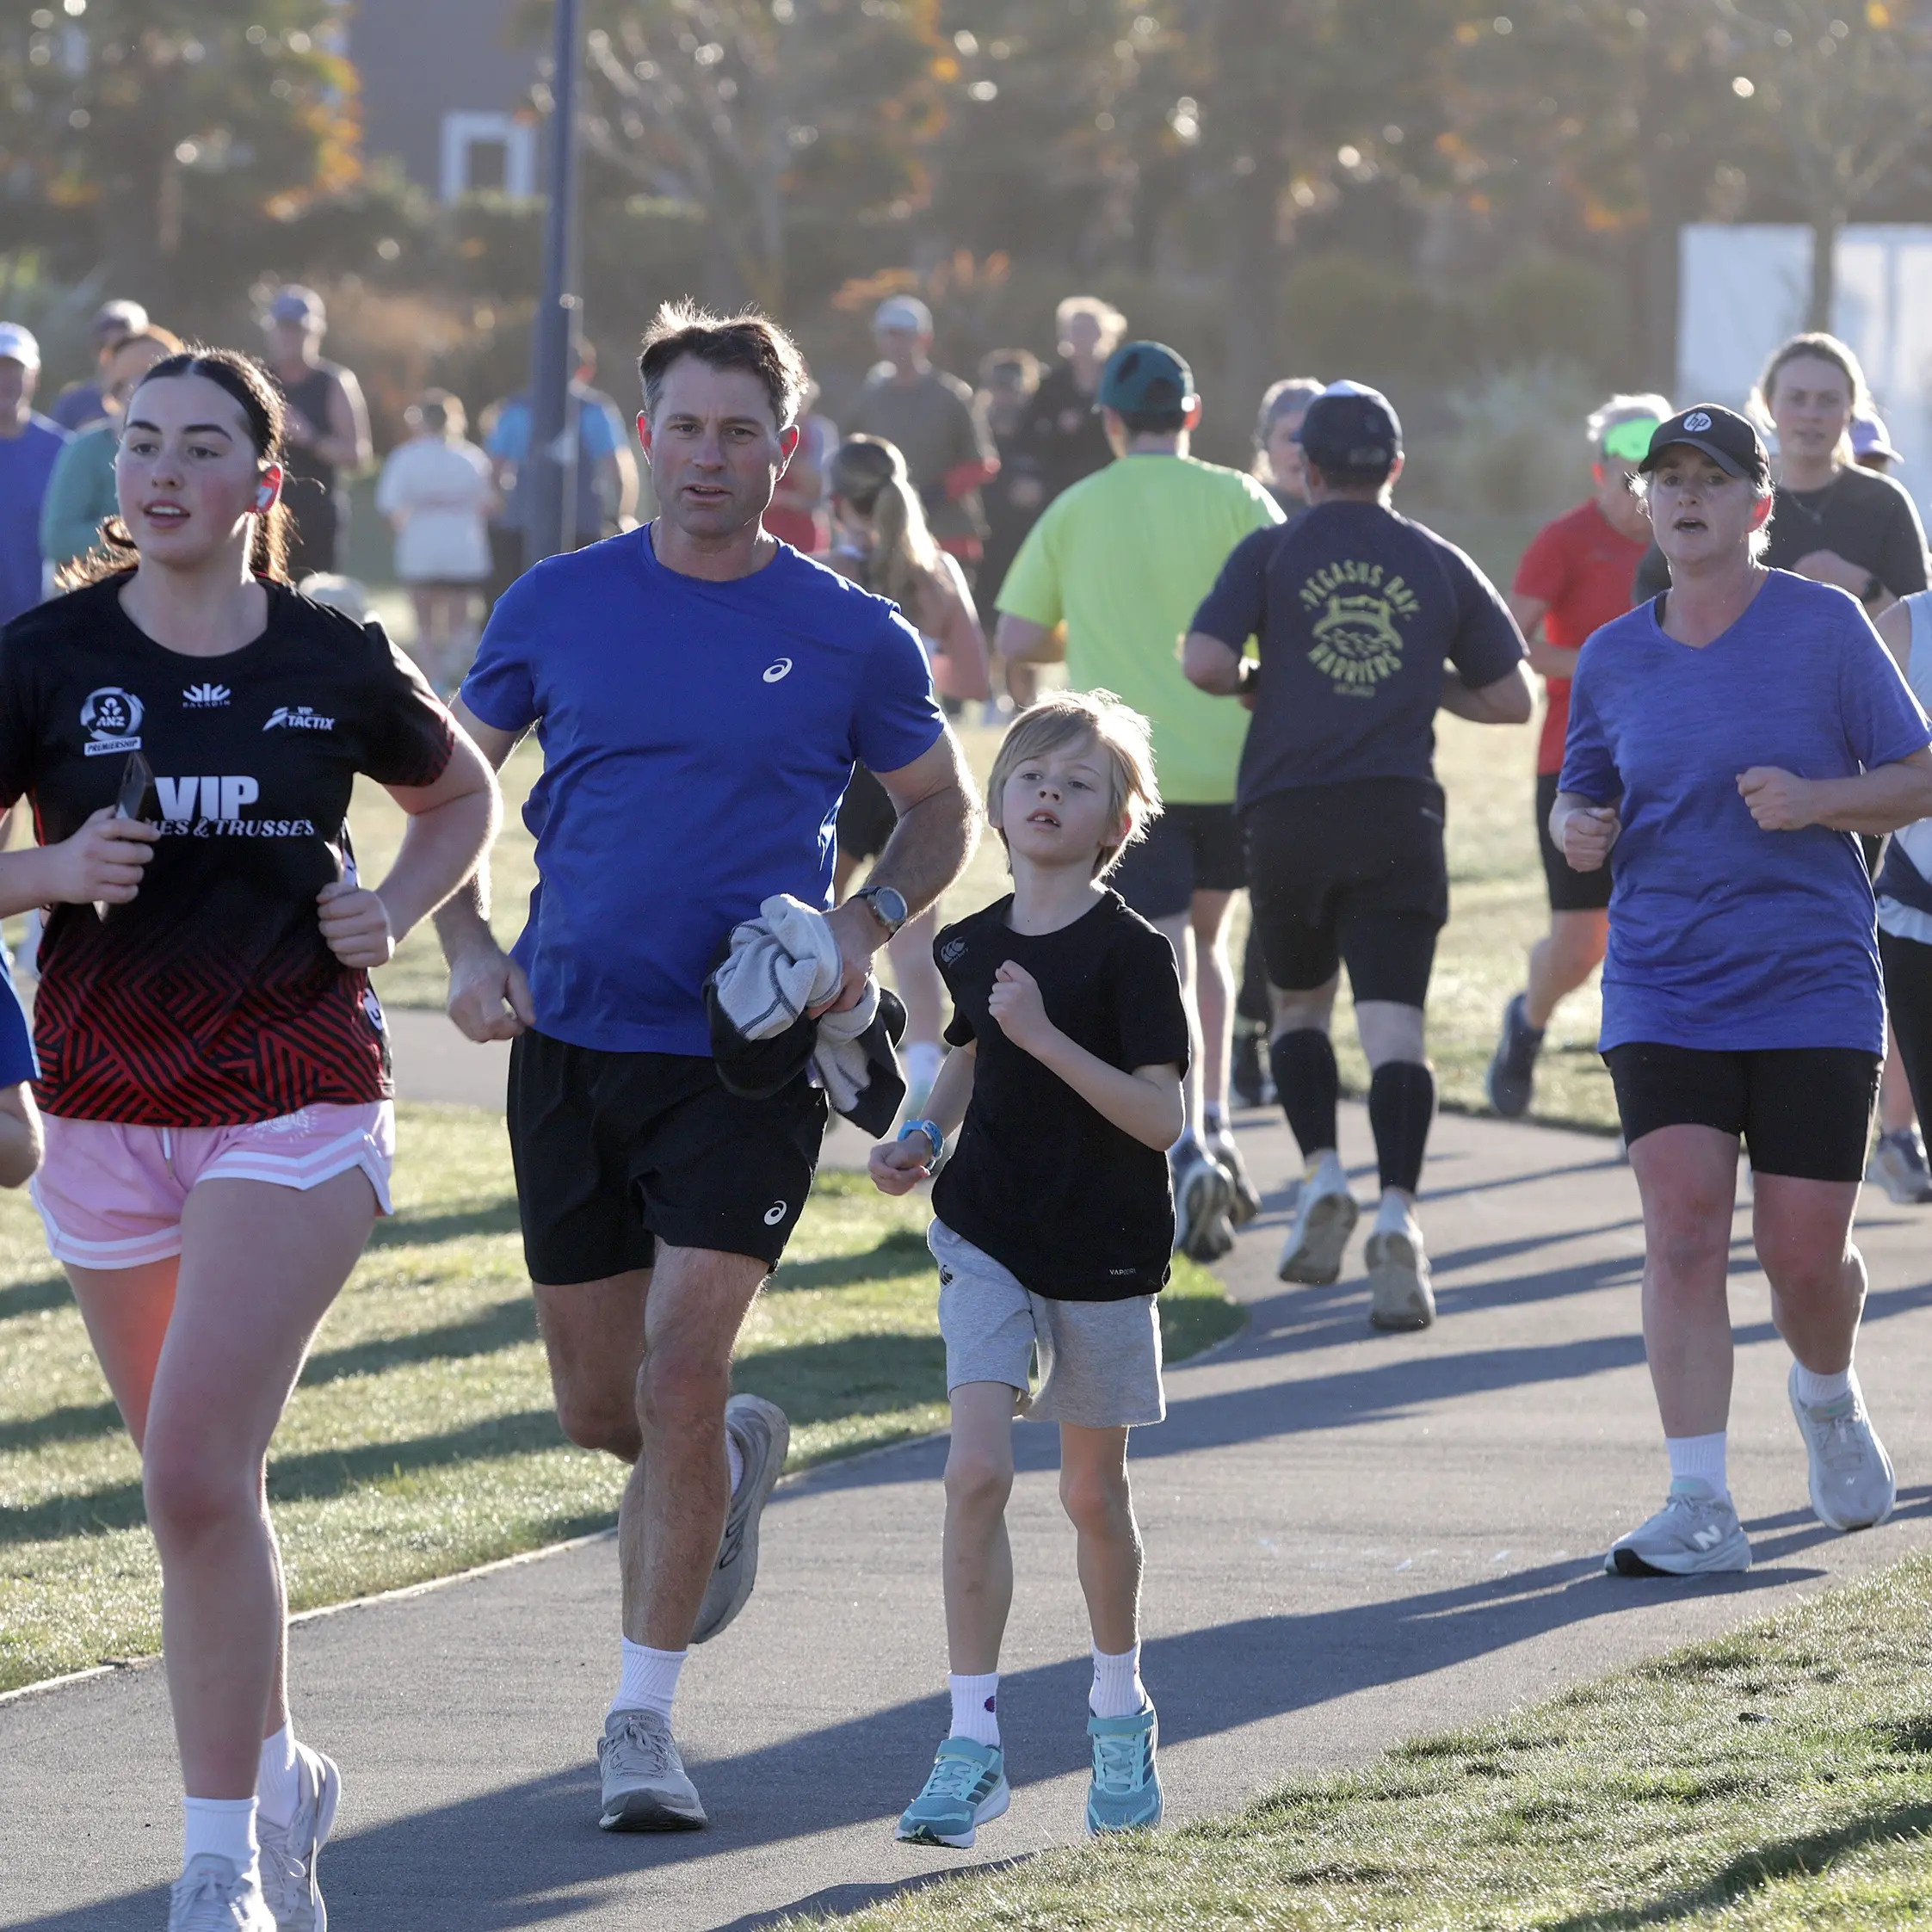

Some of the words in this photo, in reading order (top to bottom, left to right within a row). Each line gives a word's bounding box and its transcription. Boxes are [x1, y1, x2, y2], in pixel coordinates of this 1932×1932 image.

[1687, 412, 1710, 431] hp
[96, 716, 126, 727] ANZ
[287, 715, 336, 731] TACTIX
[87, 738, 139, 754] PREMIERSHIP
[154, 775, 259, 821] VIP
[214, 818, 316, 837] TRUSSES
